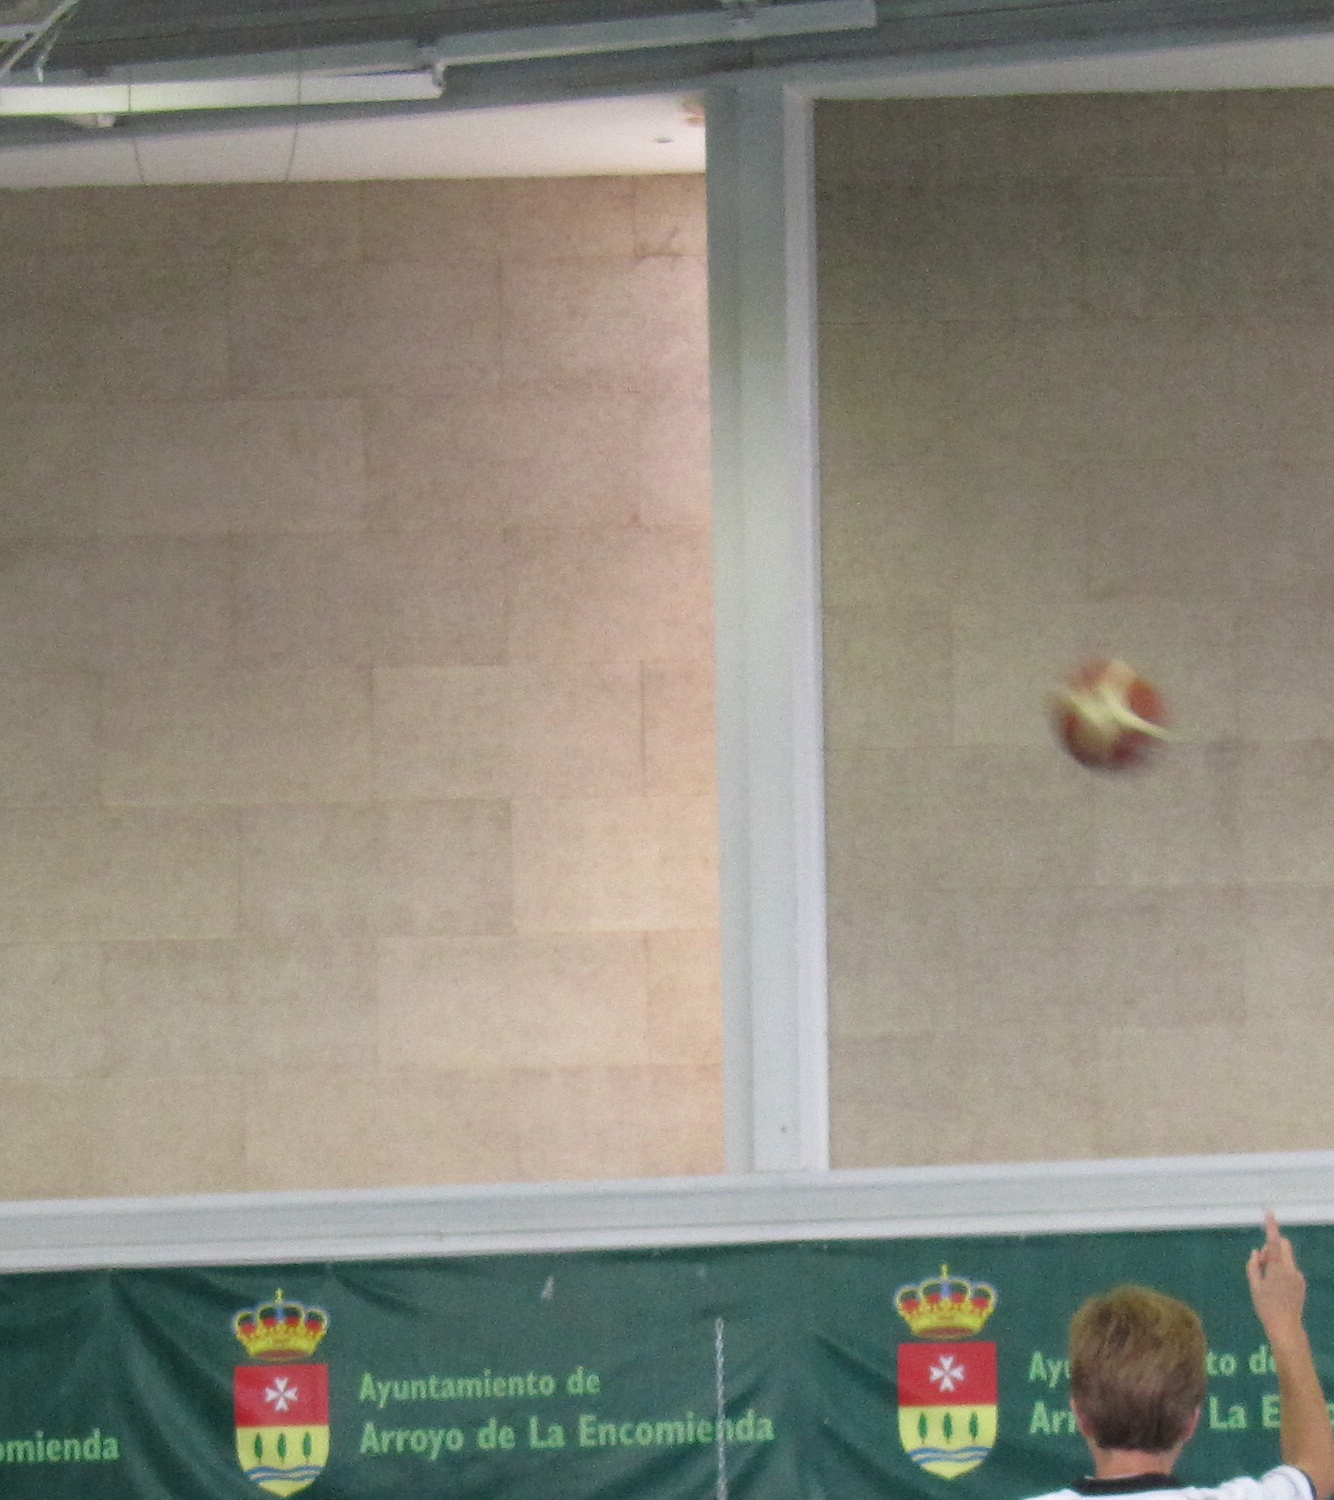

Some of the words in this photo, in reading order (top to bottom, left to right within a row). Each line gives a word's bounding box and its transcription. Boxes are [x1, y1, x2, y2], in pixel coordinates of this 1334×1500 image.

[359, 1368, 556, 1408] Ayuntamiento
[567, 1366, 601, 1395] de
[1209, 1394, 1247, 1430] La
[359, 1420, 464, 1460] Arroyo
[477, 1418, 515, 1450] de
[528, 1416, 565, 1449] La
[579, 1408, 775, 1447] Encomienda
